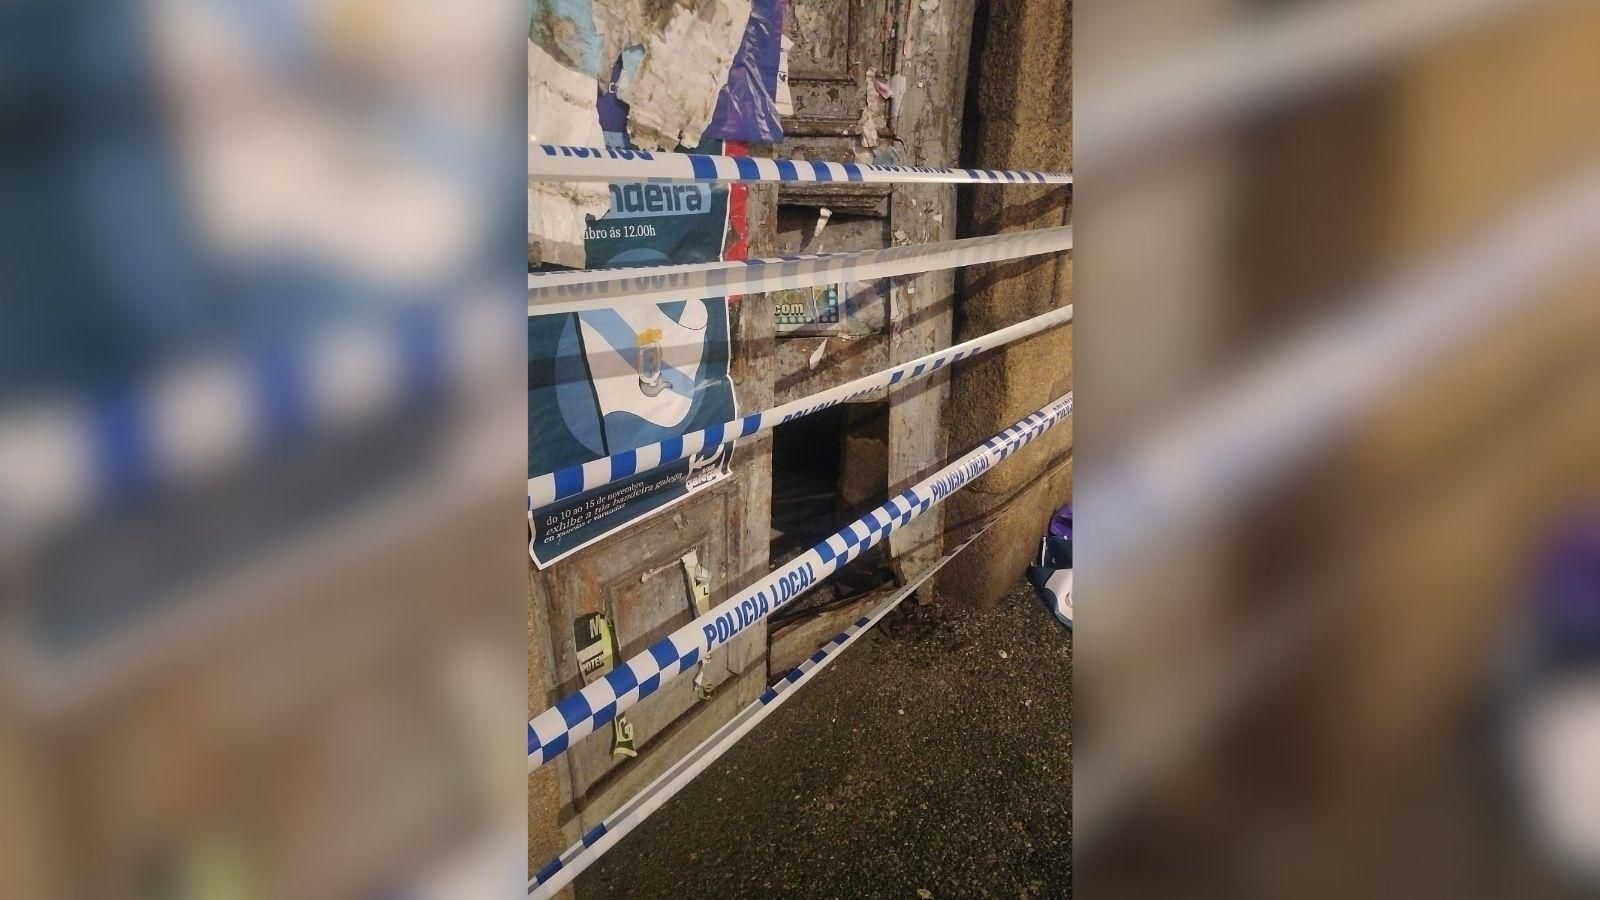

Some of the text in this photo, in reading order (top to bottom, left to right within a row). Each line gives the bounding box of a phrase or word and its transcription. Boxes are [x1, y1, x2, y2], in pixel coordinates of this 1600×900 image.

[609, 226, 621, 238] ás
[623, 224, 656, 238] 12.00h
[930, 455, 991, 502] POLICIA LOCAL
[546, 481, 644, 526] do 10 ao 15 de novembro
[546, 515, 583, 535] exhibe
[613, 485, 654, 506] bandeira
[655, 472, 683, 490] galega
[544, 535, 555, 544] en
[703, 562, 817, 652] POLICIA LOCAL
